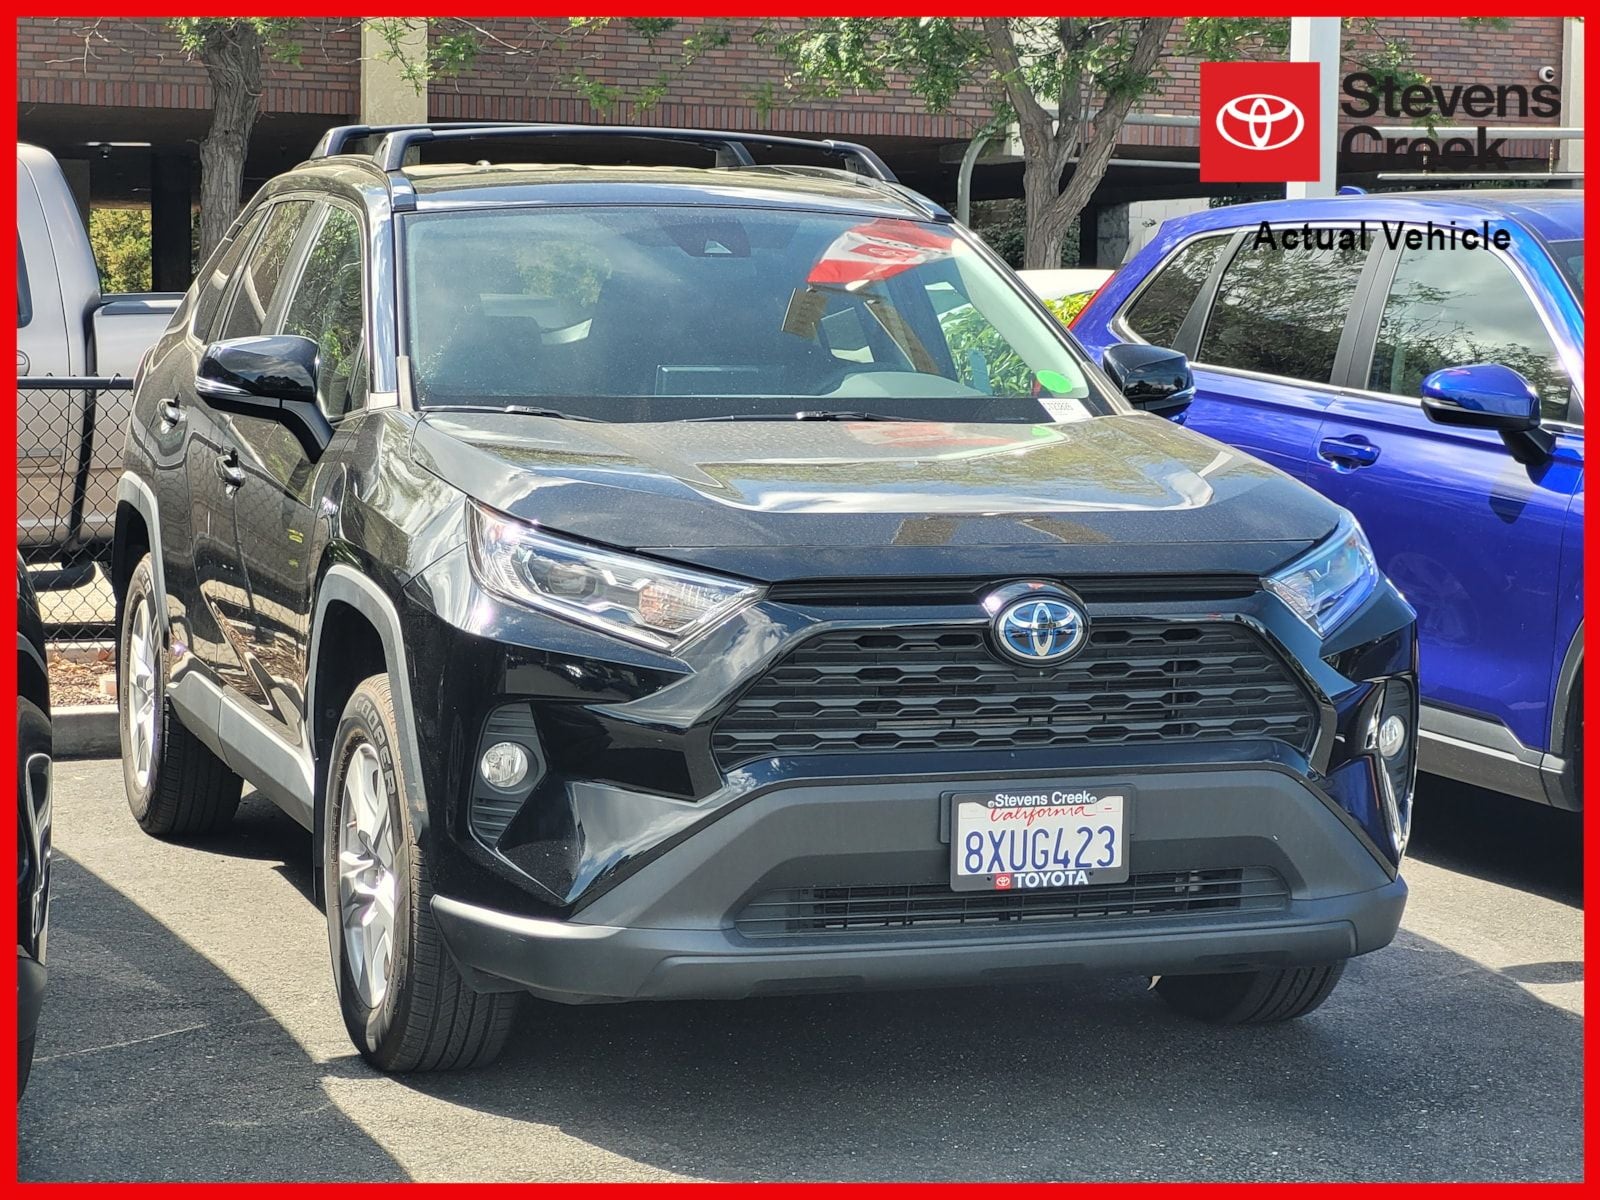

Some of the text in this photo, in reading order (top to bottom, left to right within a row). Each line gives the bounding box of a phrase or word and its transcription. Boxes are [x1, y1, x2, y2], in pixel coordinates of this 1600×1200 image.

[355, 695, 396, 795] COOPER
[995, 790, 1092, 808] Stevens Creek
[990, 804, 1097, 827] California
[964, 825, 1116, 874] 8XUG423
[1014, 870, 1089, 889] TOYOTA
